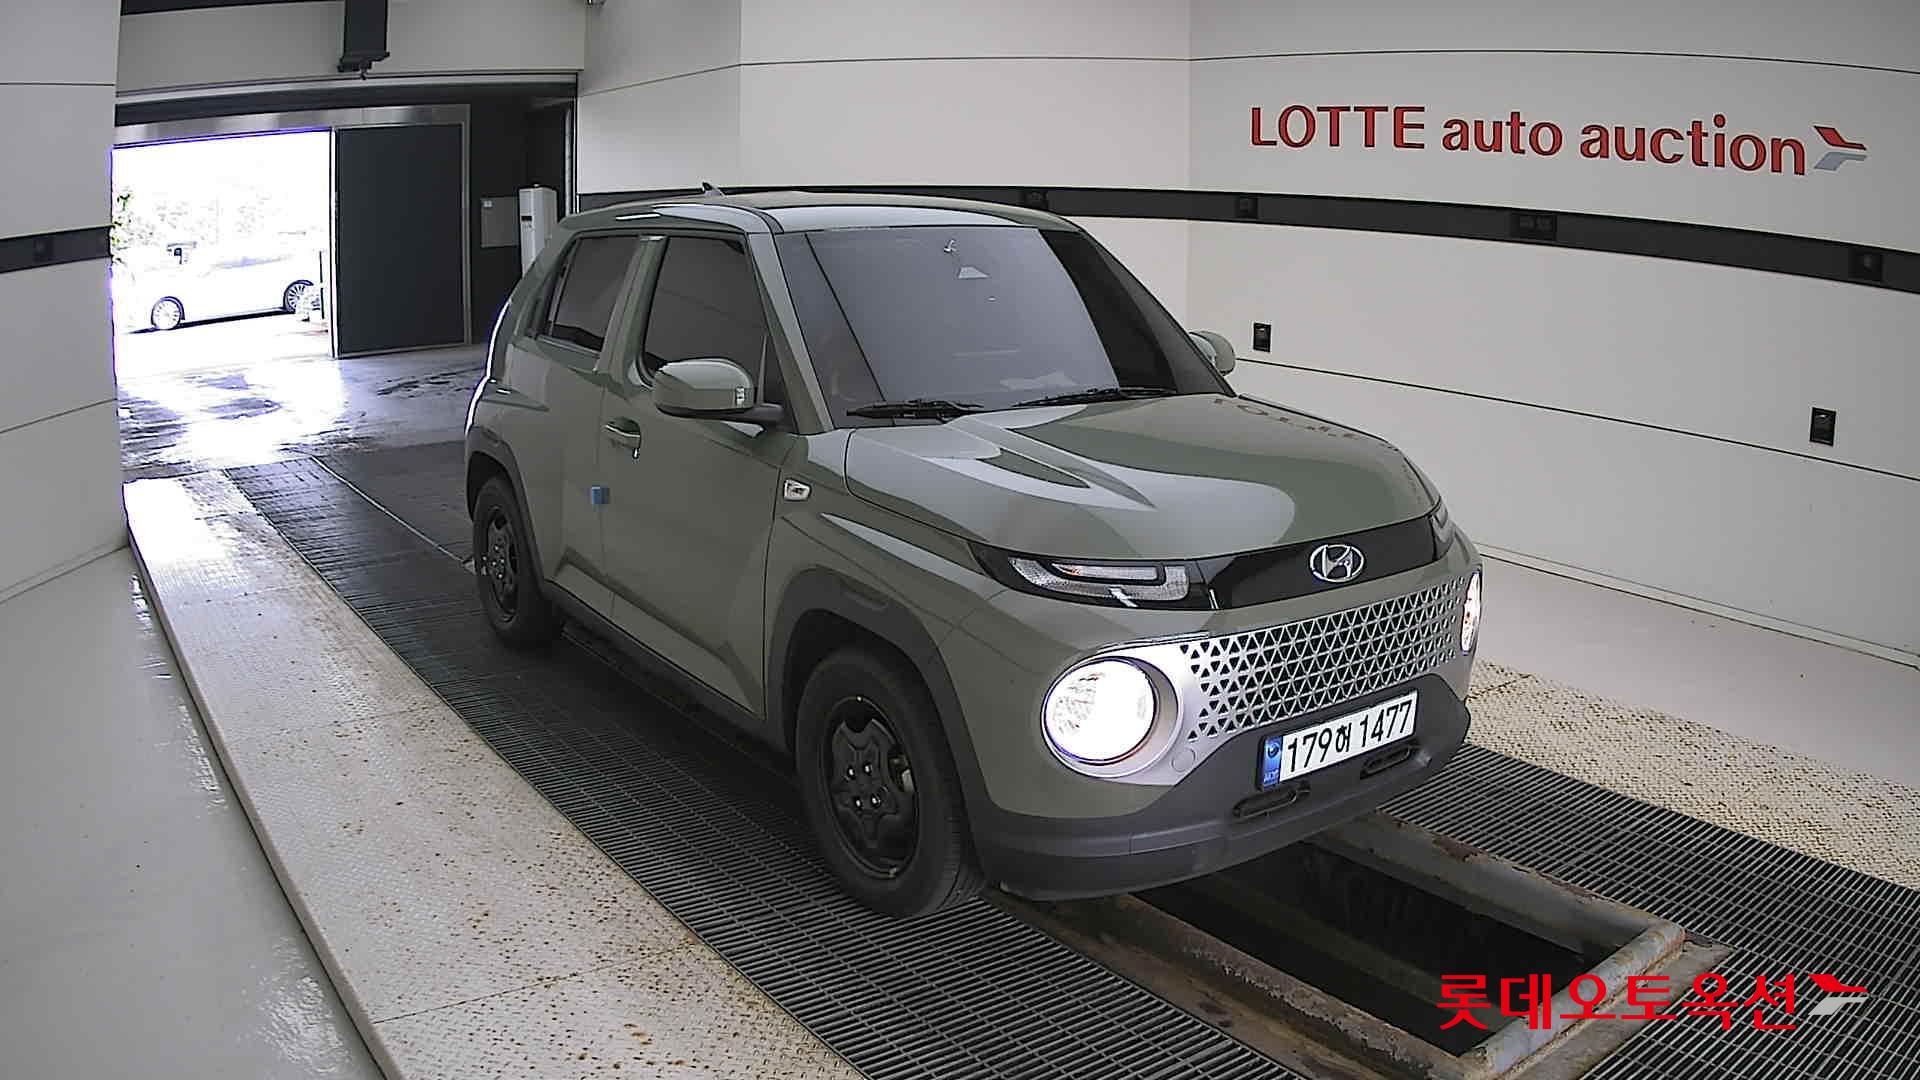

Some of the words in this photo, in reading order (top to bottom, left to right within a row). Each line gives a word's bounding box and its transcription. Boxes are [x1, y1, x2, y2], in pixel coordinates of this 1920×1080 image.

[1250, 105, 1426, 149] LOTTE
[1442, 111, 1563, 156] auto
[1580, 114, 1806, 176] auction
[1287, 722, 1352, 773] 179허
[1359, 699, 1413, 748] 1477
